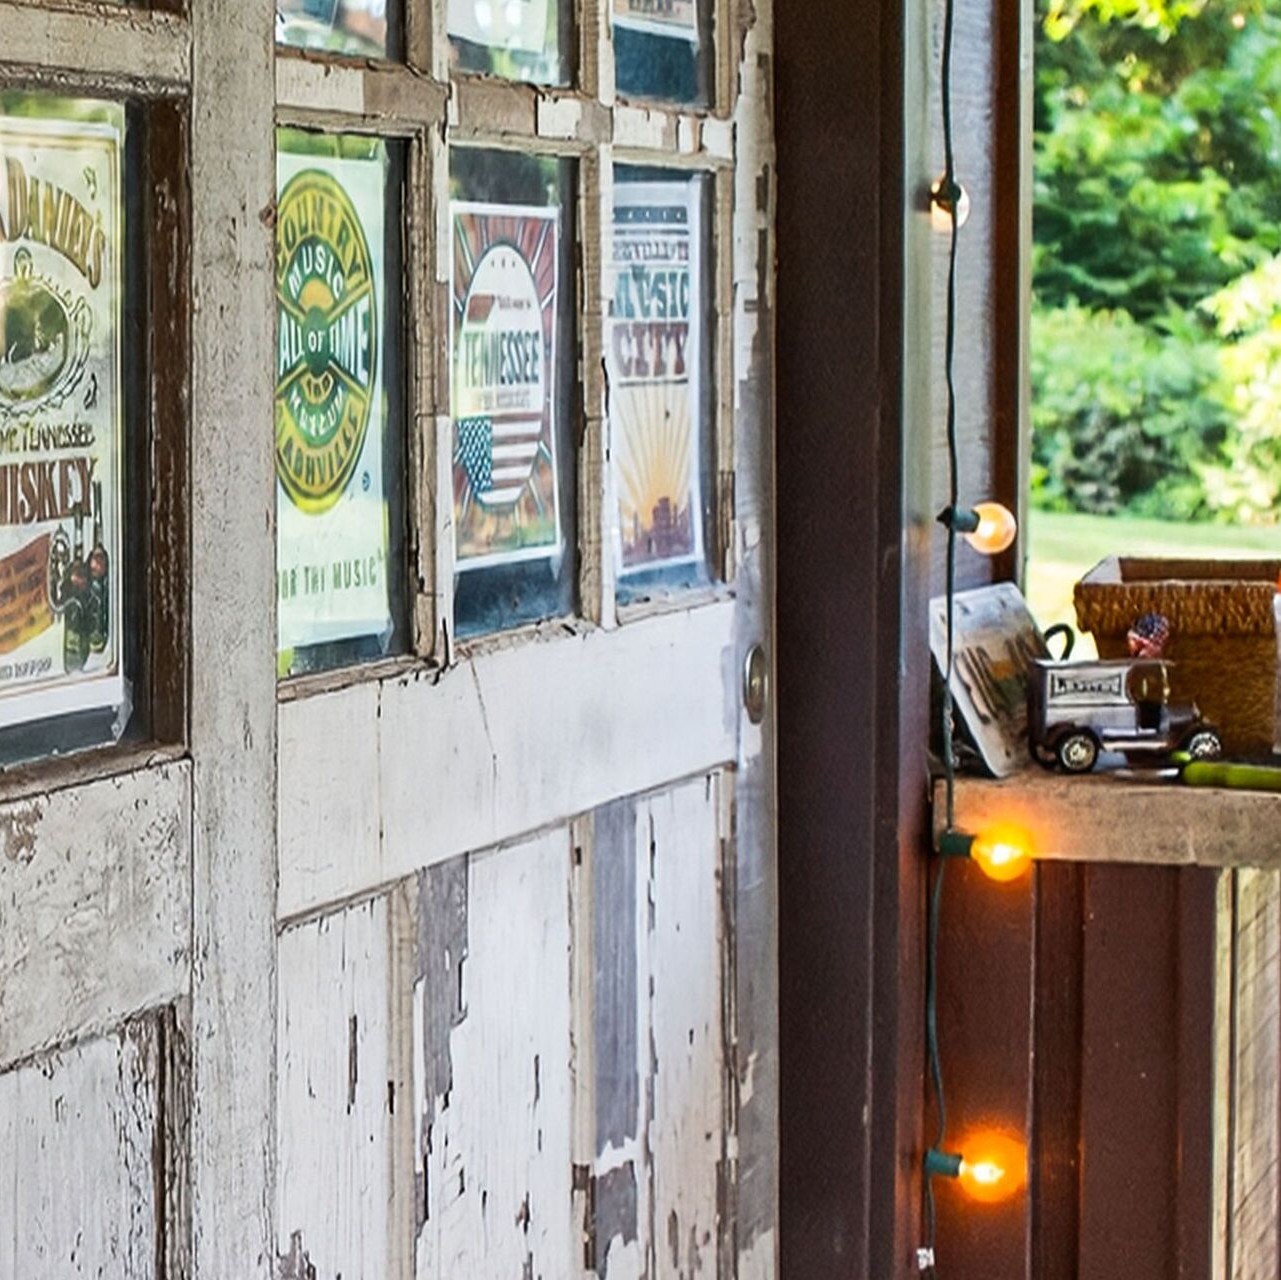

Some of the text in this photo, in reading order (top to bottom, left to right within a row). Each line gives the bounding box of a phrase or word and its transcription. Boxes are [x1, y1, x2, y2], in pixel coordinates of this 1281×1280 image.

[288, 245, 344, 302] MUSIC
[279, 308, 306, 376] ALL
[307, 330, 326, 353] OF
[613, 322, 689, 377] CITY
[332, 555, 377, 591] MUSIC
